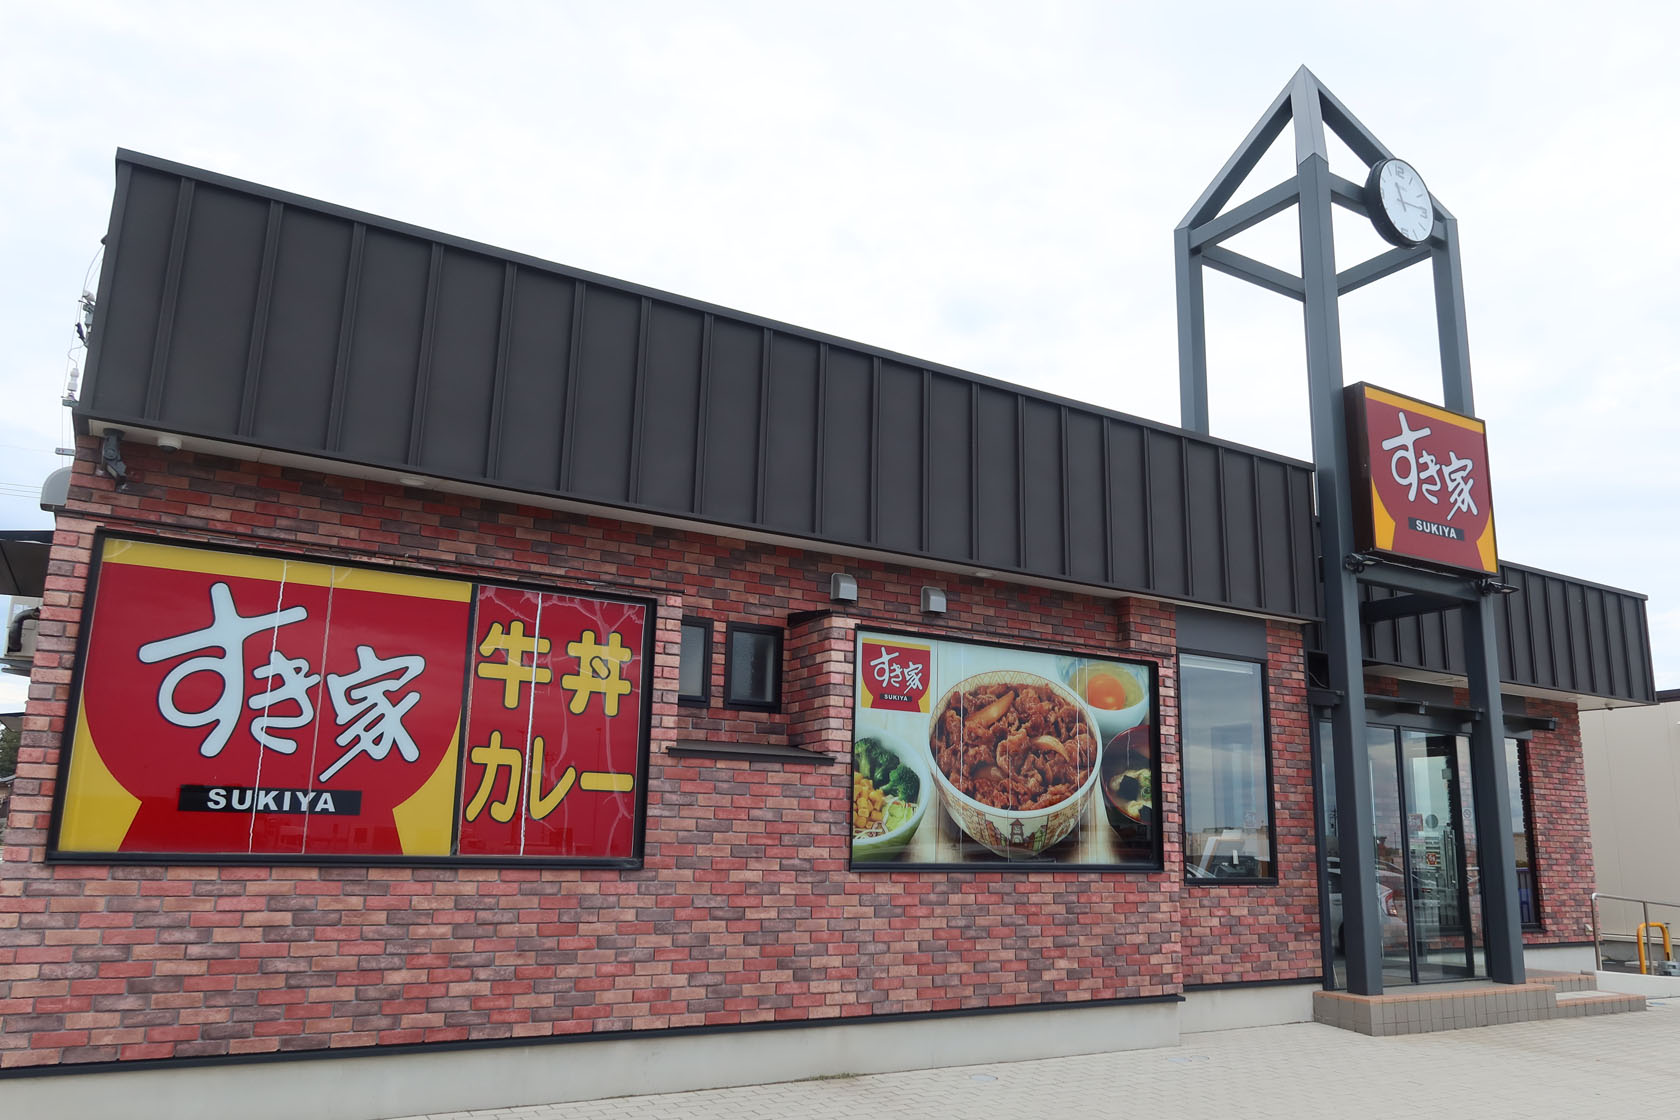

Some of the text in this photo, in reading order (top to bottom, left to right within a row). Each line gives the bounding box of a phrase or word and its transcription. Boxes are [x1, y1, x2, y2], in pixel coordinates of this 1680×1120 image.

[1394, 163, 1405, 179] 12
[1381, 411, 1478, 521] すき家
[1415, 519, 1457, 539] SUKIYA
[138, 581, 425, 782] すき家
[477, 620, 633, 717] 牛丼
[869, 646, 923, 694] すき家
[883, 694, 908, 702] SUKIYA
[207, 788, 336, 813] SUKIYA
[465, 730, 635, 823] カレー
